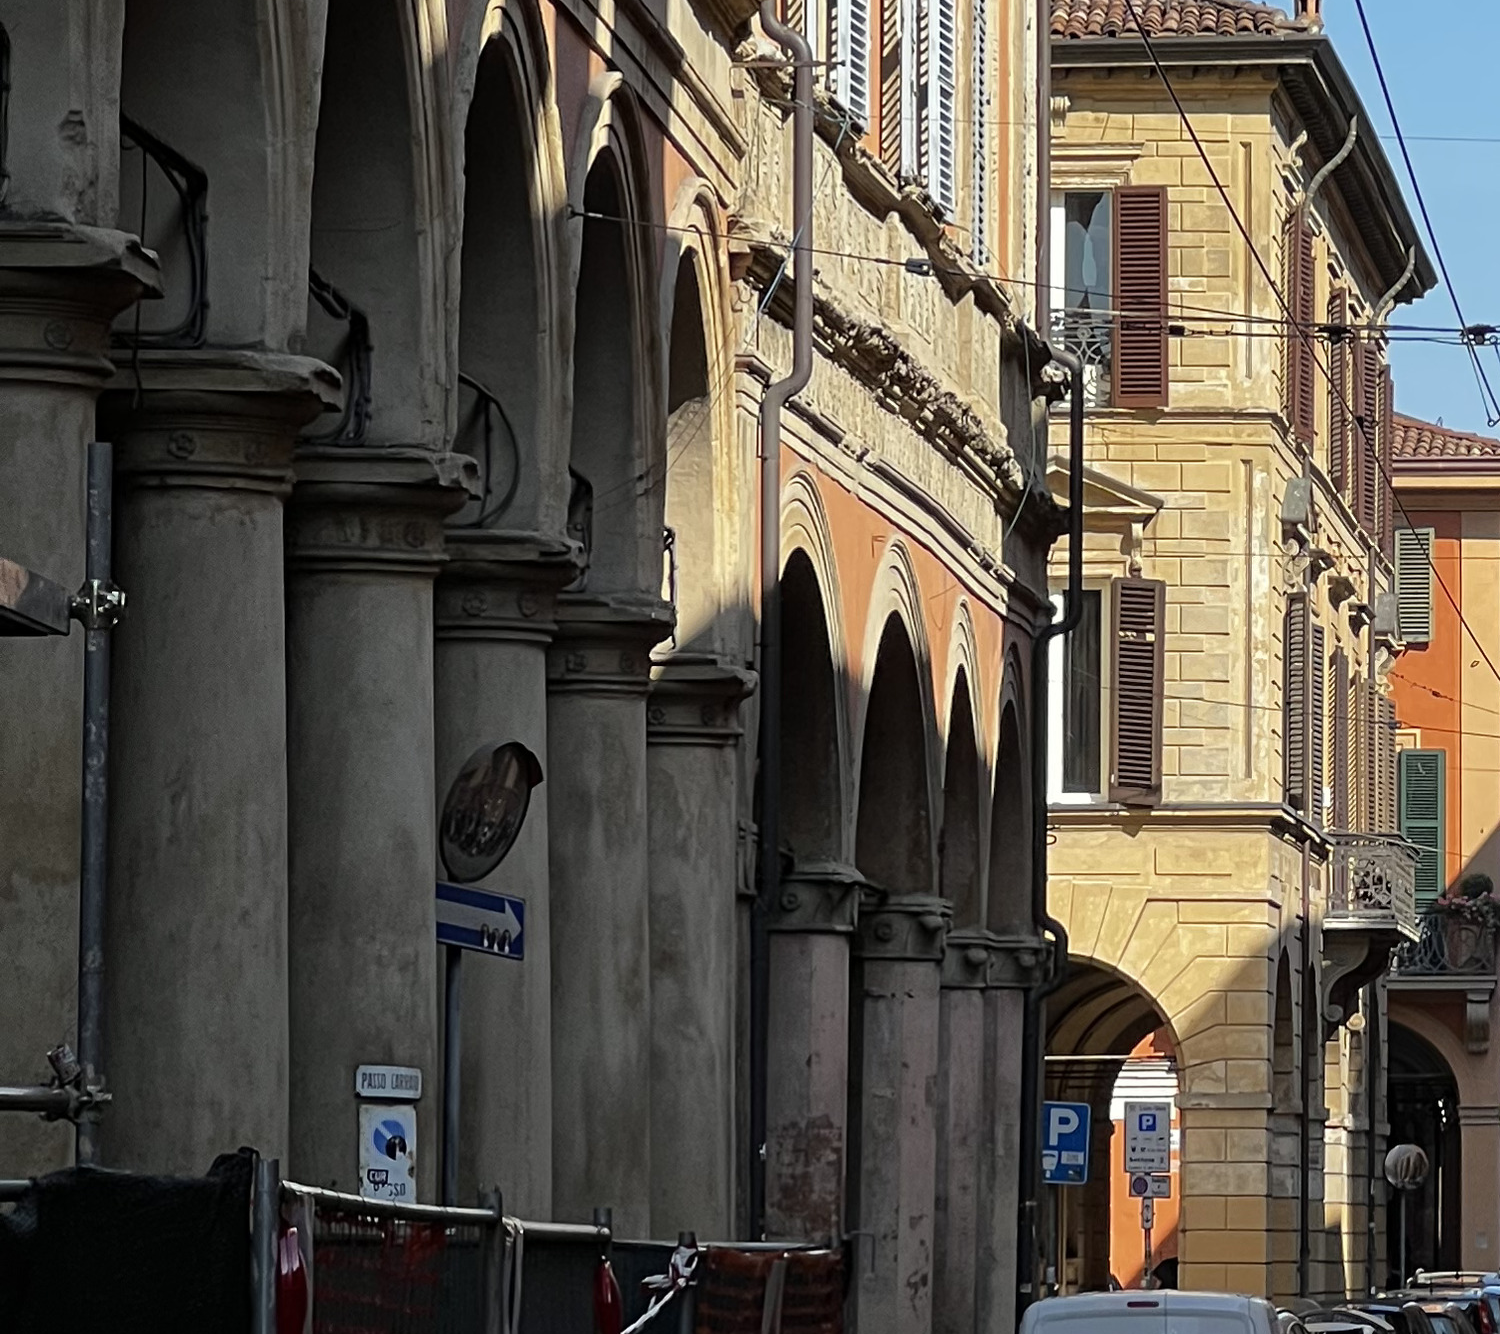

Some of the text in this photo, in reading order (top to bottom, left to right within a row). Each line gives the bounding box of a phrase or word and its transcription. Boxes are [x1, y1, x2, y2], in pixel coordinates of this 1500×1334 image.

[361, 1071, 387, 1090] PASSO
[1049, 1107, 1080, 1146] P
[1141, 1115, 1154, 1130] P
